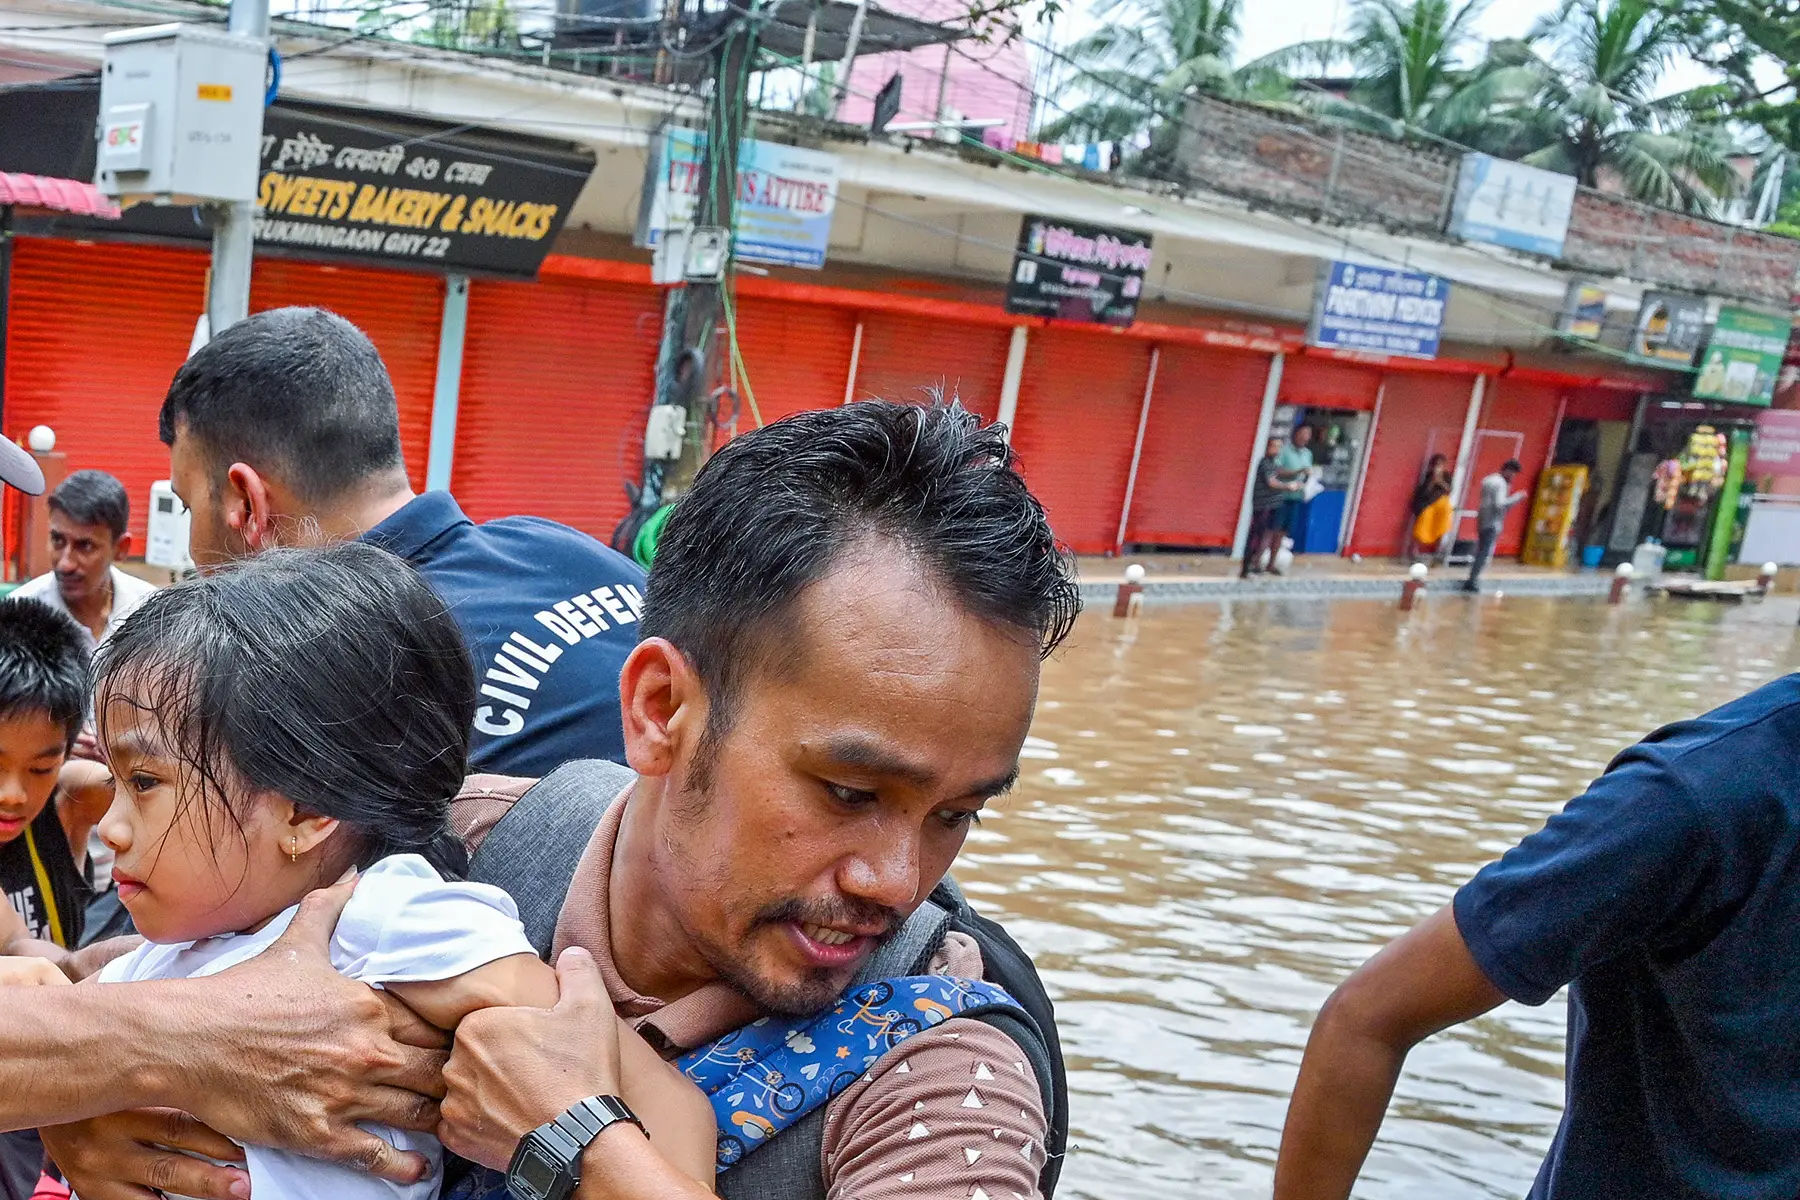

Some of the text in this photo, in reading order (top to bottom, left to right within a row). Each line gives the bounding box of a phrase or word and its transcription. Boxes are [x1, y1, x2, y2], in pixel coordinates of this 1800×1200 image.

[256, 171, 558, 242] SWEETS BAKERY & SNACKS
[421, 236, 452, 258] 22
[473, 631, 564, 736] CIVIL
